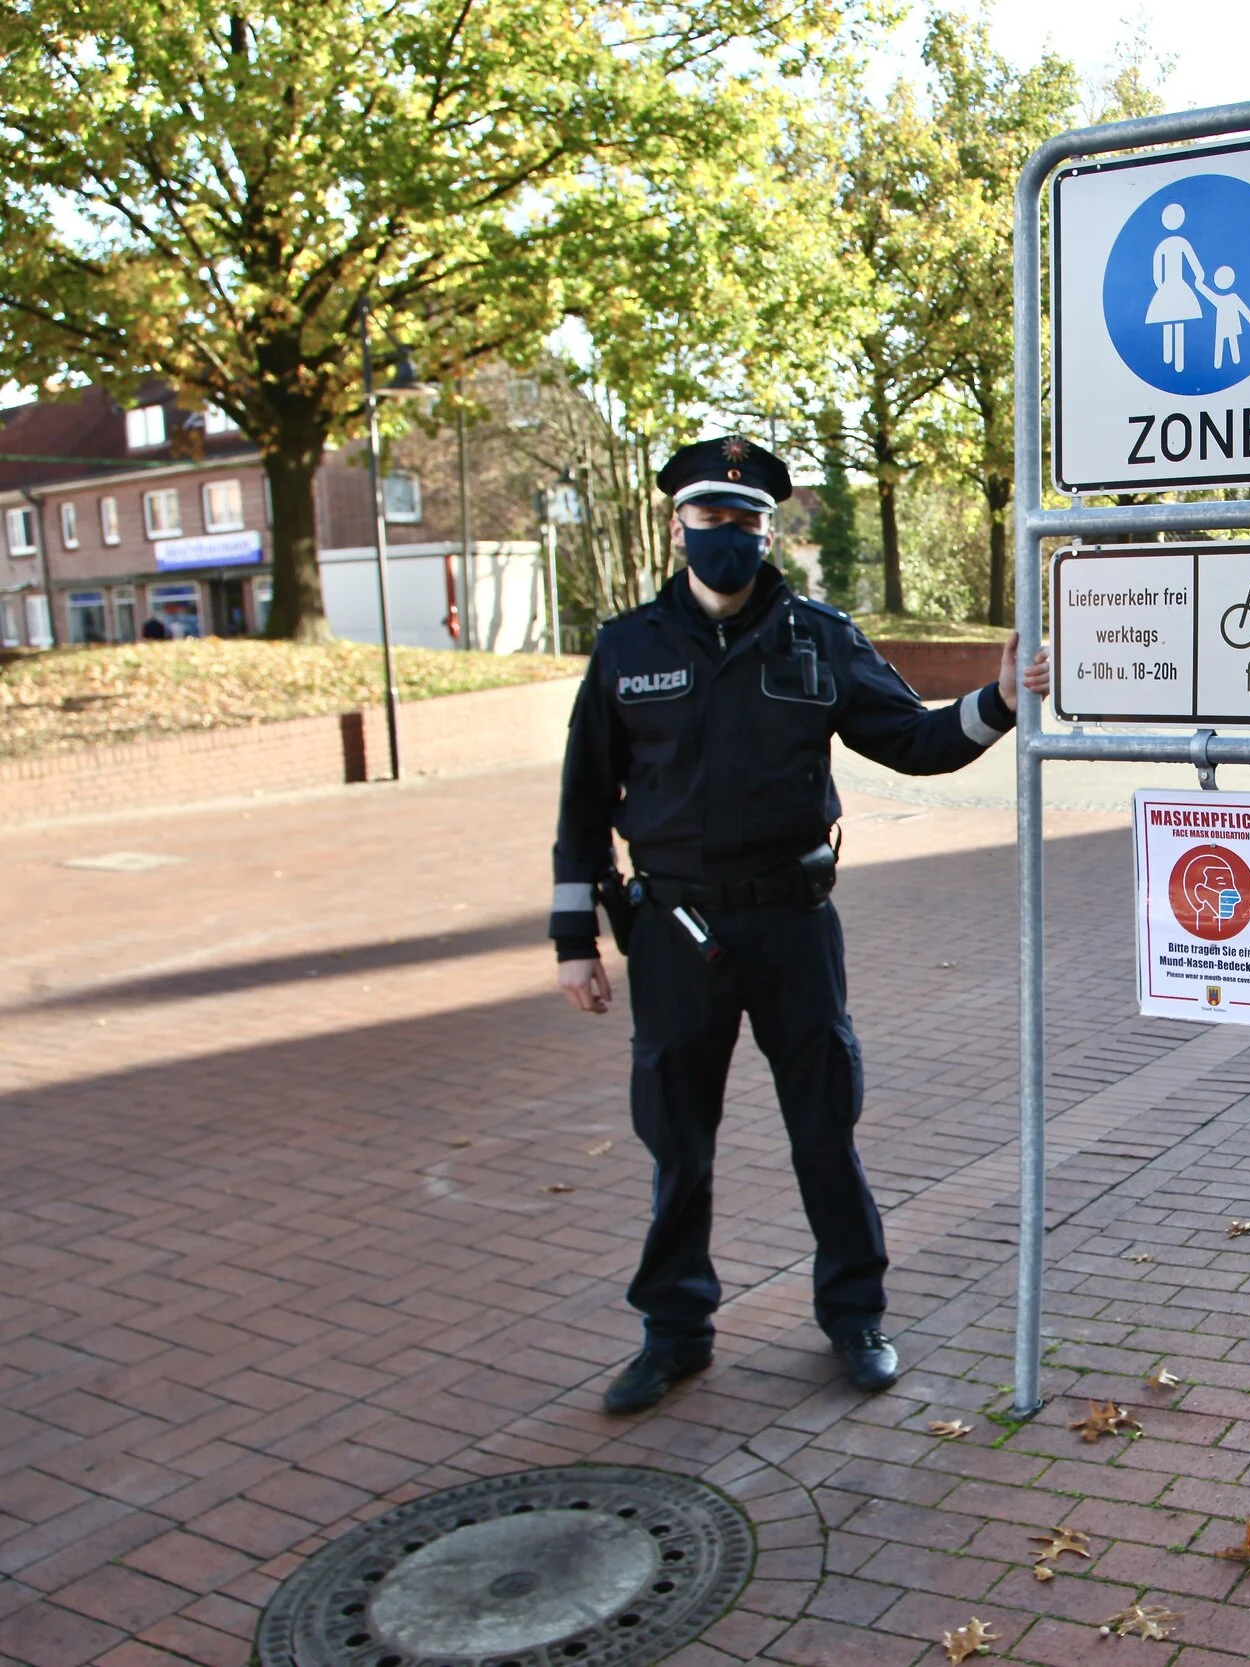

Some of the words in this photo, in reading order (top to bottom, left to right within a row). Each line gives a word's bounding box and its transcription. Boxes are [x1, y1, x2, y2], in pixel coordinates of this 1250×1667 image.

[1068, 588, 1159, 607] Lieferverkehr
[1163, 587, 1187, 605] frei
[1096, 625, 1158, 647] werktags
[1077, 662, 1112, 680] 6-10h
[1117, 667, 1128, 680] u.
[1132, 662, 1177, 680] 18-20h
[619, 669, 687, 694] POLIZEI
[1172, 829, 1188, 838] FACE
[1189, 829, 1209, 839] MASK
[1210, 831, 1250, 840] OBLIGATION
[1168, 943, 1189, 953] Bitte
[1191, 944, 1220, 956] tragen
[1222, 946, 1237, 957] Sie
[1166, 971, 1184, 979] Please
[1204, 974, 1236, 983] mouth-nose
